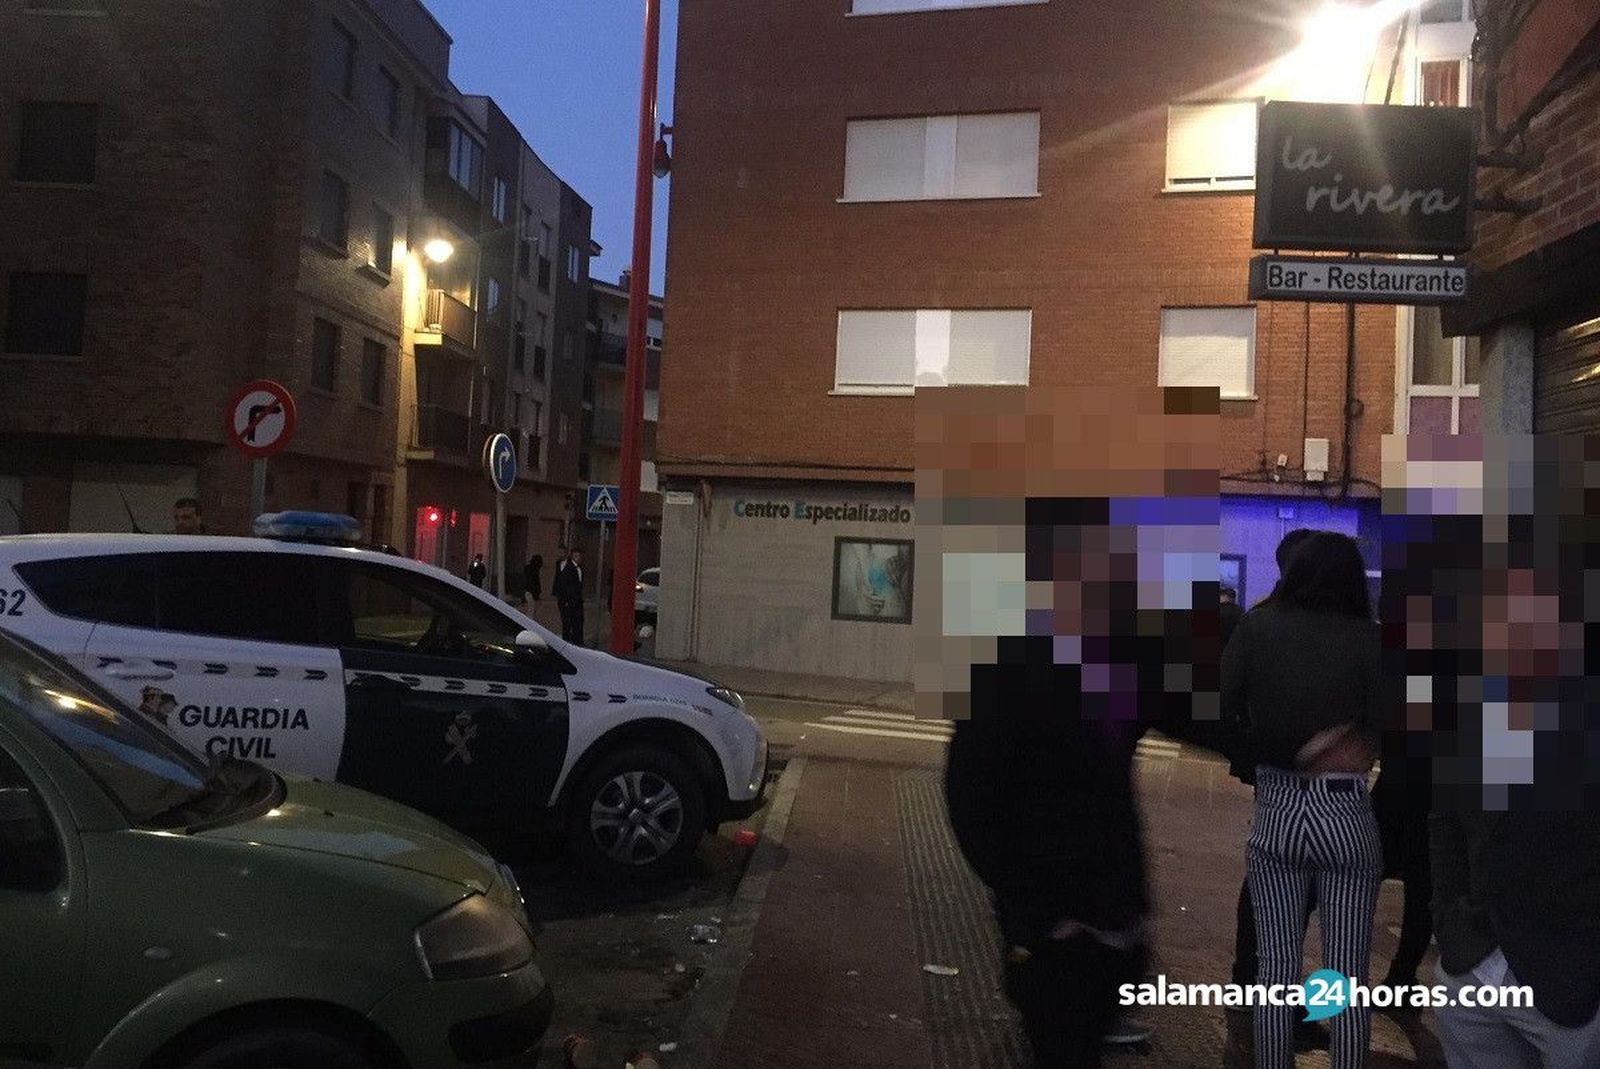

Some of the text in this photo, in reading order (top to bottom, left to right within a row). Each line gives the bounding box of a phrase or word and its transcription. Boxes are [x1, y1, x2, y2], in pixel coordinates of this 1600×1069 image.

[1282, 135, 1333, 171] la
[1305, 173, 1461, 215] rivera
[1267, 264, 1308, 289] Bar
[1327, 266, 1464, 293] Restaurante
[733, 499, 911, 525] Centro Especializado
[179, 704, 309, 730] GUARDIA
[205, 735, 276, 759] CIVIL
